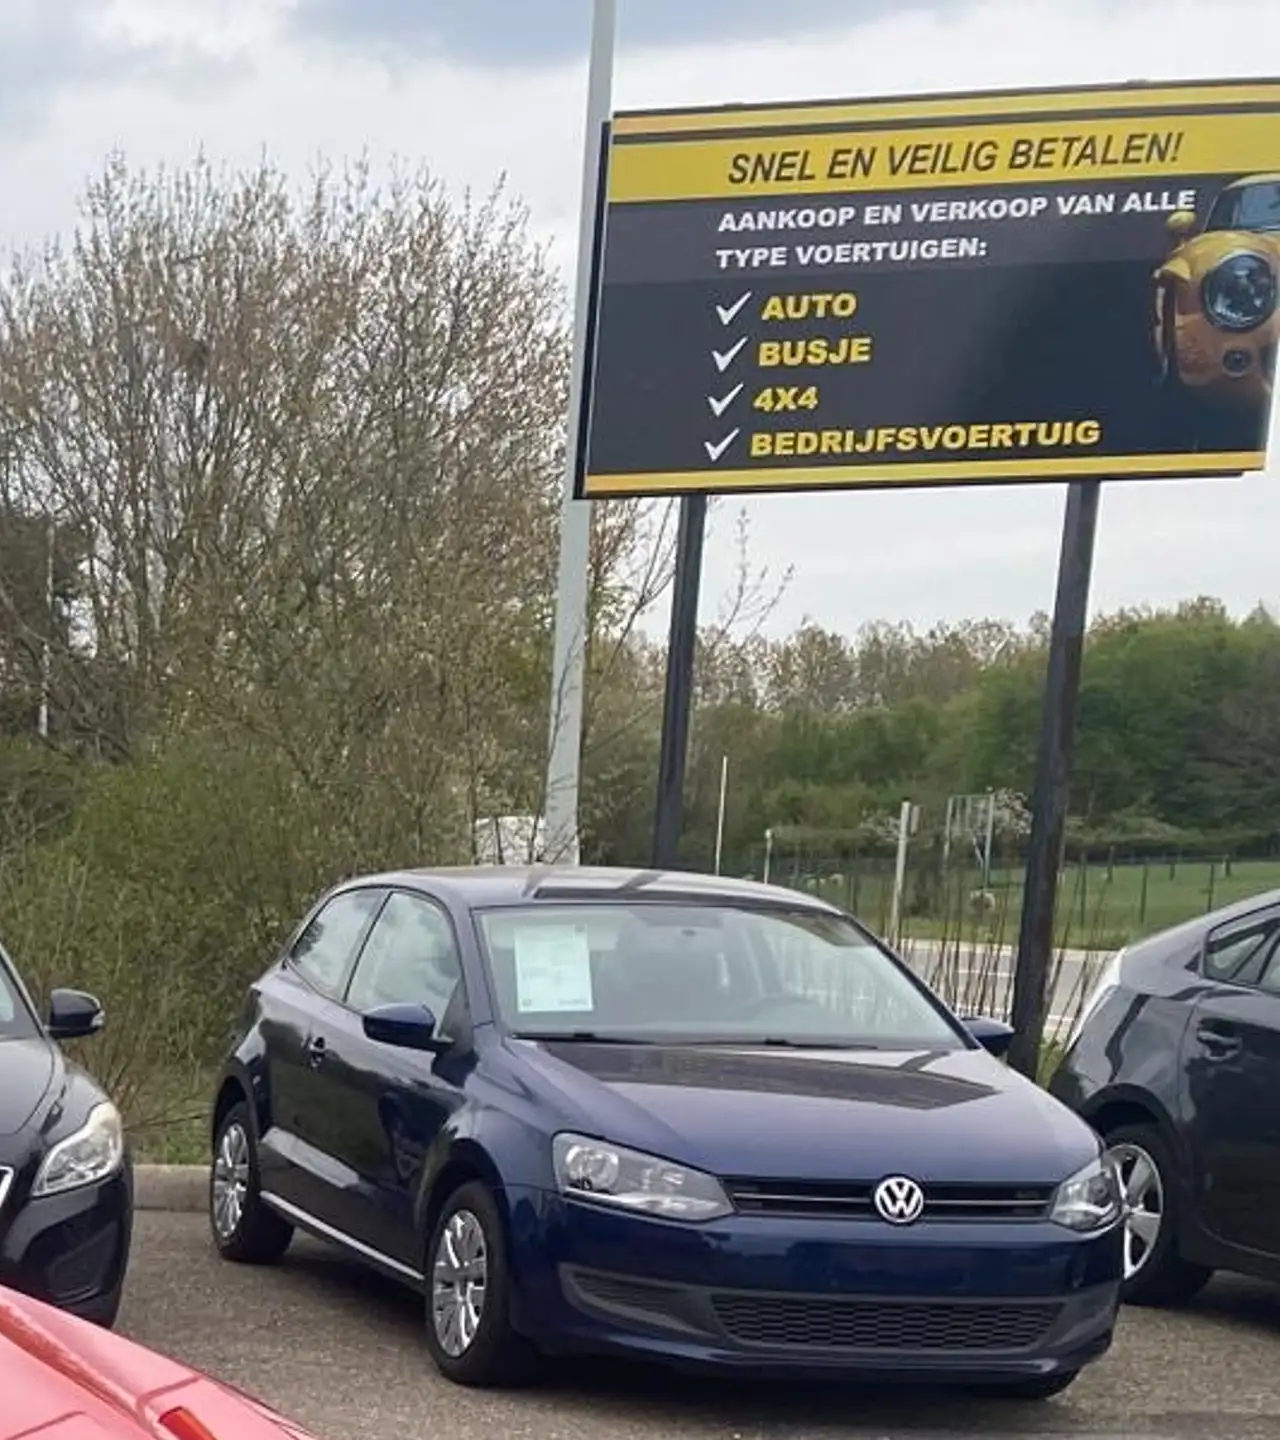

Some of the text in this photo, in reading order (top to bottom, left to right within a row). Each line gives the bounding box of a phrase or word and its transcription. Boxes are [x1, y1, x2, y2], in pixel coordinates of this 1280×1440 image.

[728, 132, 1185, 184] SNEL EN VEILIG BETALEN!
[718, 189, 1197, 233] AANKOOP EN VERKOOP VAN ALLE
[715, 236, 987, 270] TYPE VOERTUIGEN:
[761, 292, 858, 321] AUTO
[758, 336, 872, 367] BUSJE
[752, 386, 819, 411] 4X4
[750, 419, 1102, 457] BEDRIJFSVOERTUIG
